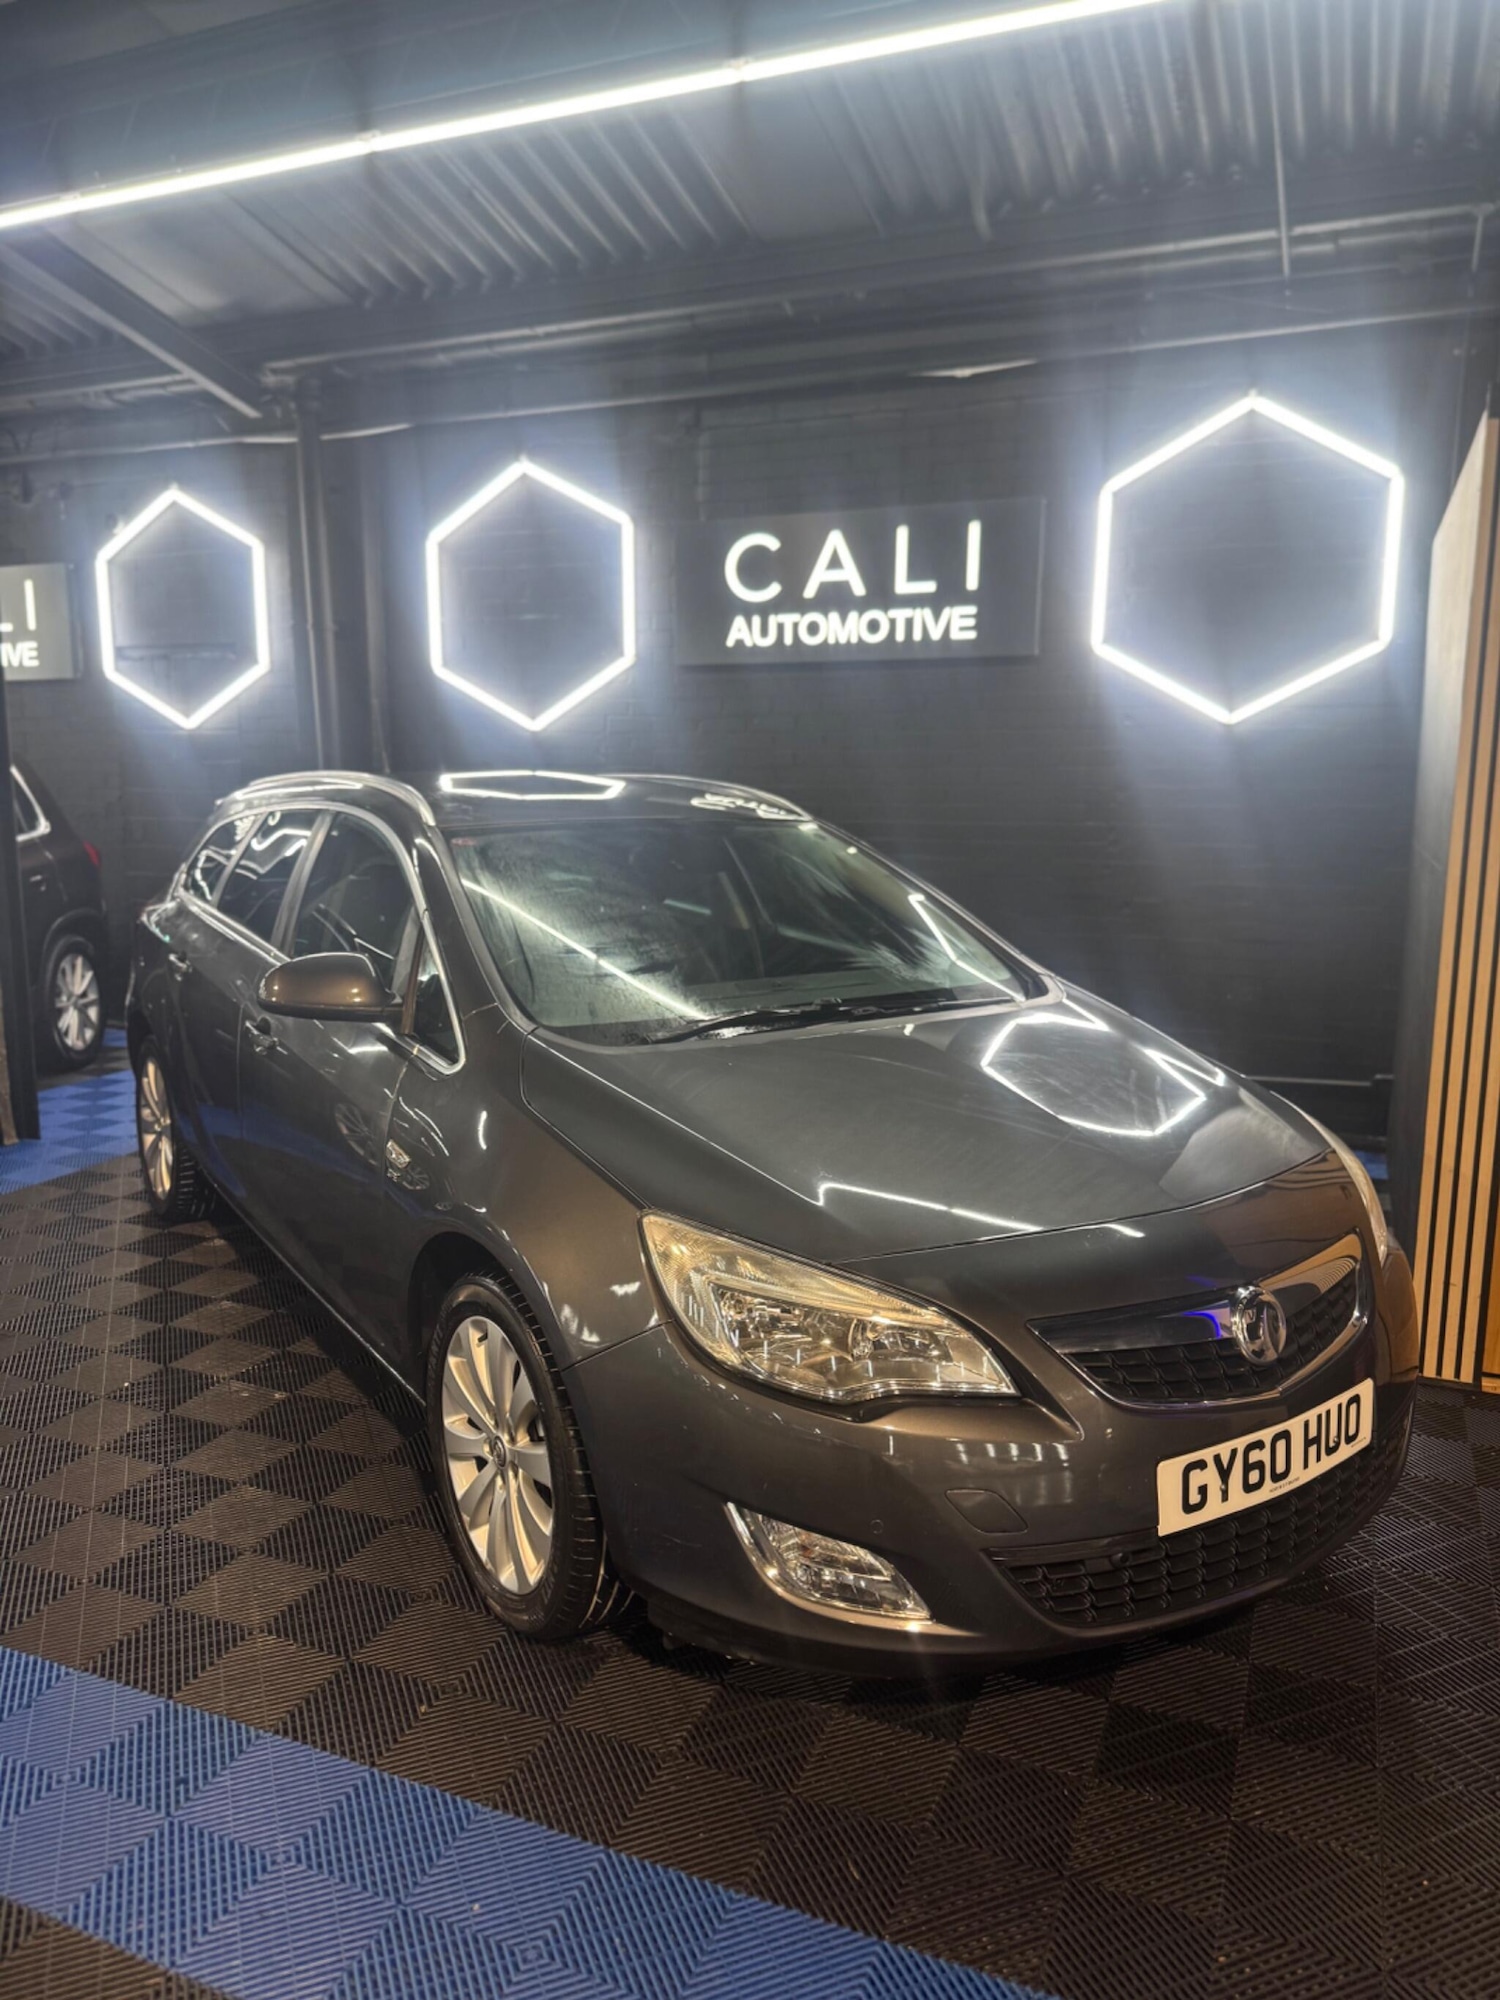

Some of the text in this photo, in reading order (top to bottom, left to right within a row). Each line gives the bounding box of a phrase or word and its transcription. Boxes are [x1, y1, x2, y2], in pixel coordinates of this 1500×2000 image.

[724, 519, 981, 602] CALI
[726, 605, 978, 648] AUTOMOTIVE
[1181, 1393, 1362, 1515] GY60 HUO
